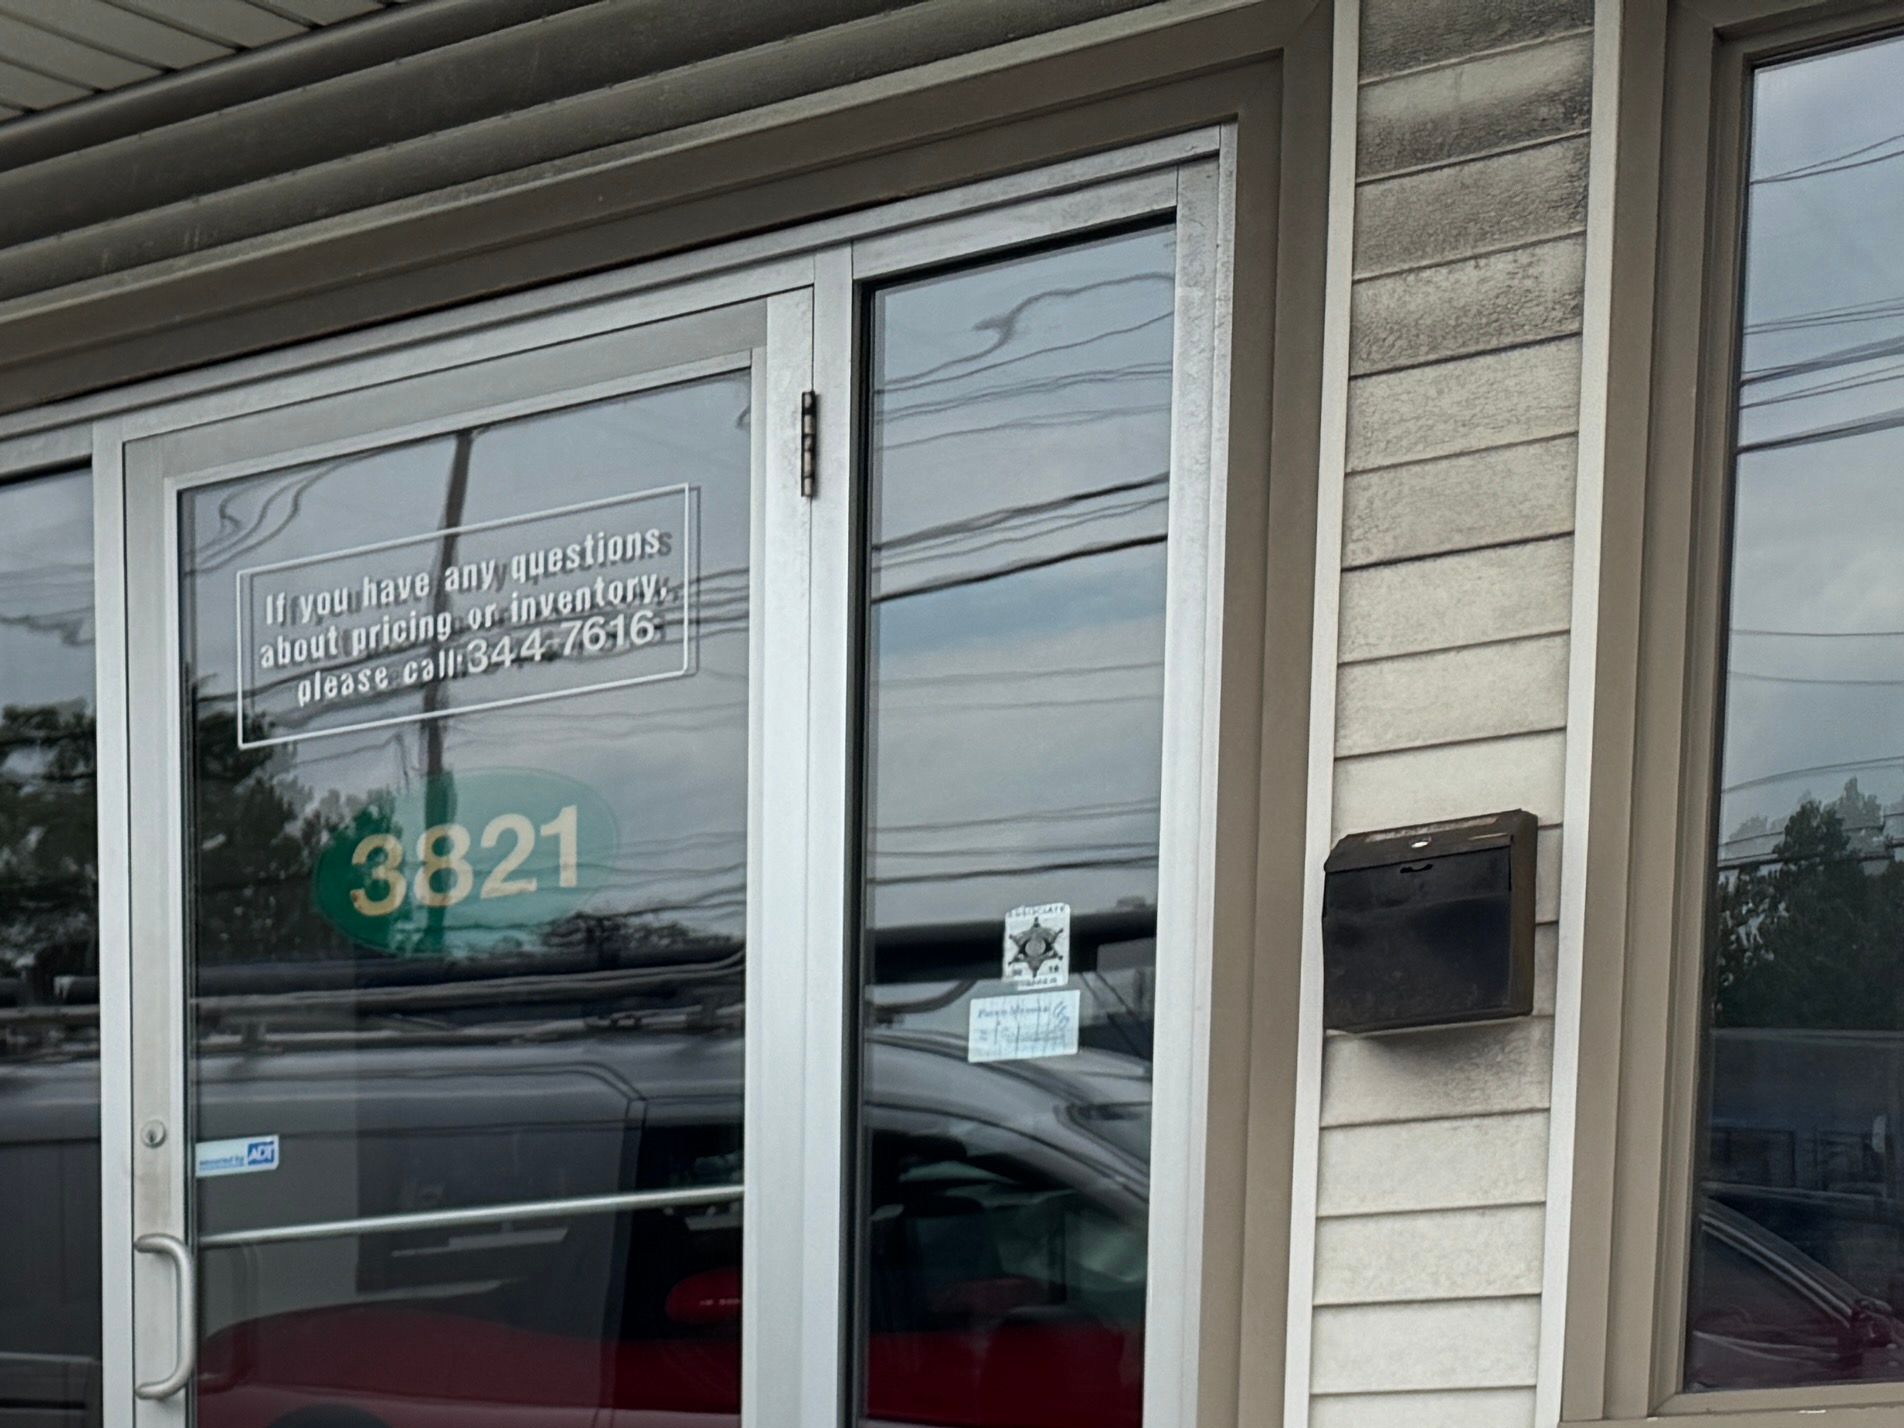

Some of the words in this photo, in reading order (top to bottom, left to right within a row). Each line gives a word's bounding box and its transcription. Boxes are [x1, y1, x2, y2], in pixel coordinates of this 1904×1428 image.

[260, 625, 338, 669] about
[351, 609, 453, 656] pricing
[467, 602, 497, 630] or
[511, 571, 669, 624] inventory,
[265, 593, 286, 625] If
[299, 585, 349, 623] you
[362, 571, 429, 609] have
[444, 558, 496, 591] any
[511, 527, 661, 582] questions
[297, 664, 389, 707] please
[349, 804, 578, 916] 3821
[248, 1142, 274, 1162] ADT
